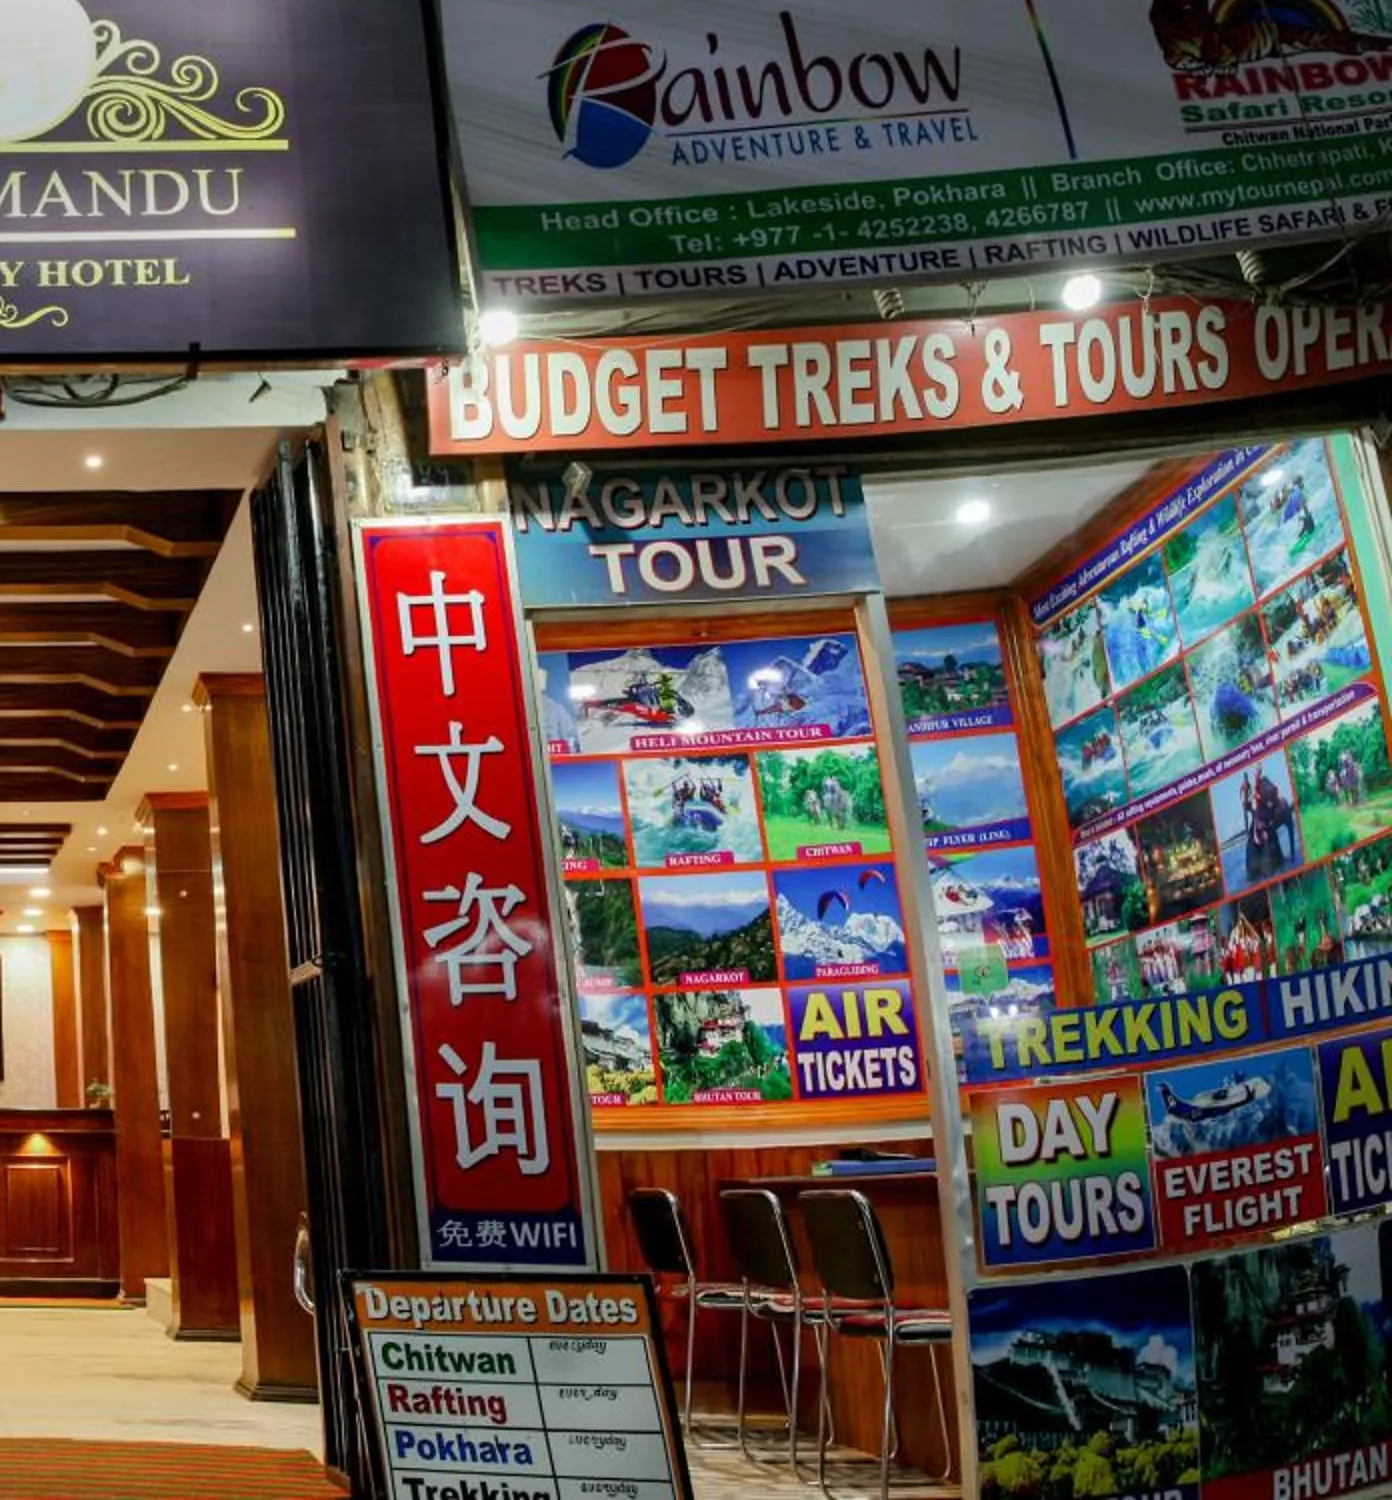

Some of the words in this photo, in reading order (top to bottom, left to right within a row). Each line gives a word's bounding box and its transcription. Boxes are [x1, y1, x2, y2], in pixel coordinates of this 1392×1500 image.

[535, 10, 961, 165] Rainbow
[1180, 98, 1289, 123] Safari
[1300, 91, 1392, 114] Reso
[671, 126, 841, 167] ADVENTURE
[853, 126, 872, 150] &
[882, 115, 978, 147] TRAVEL
[1222, 129, 1290, 146] Chitwan
[1293, 117, 1360, 141] National
[540, 206, 619, 233] Head
[629, 204, 719, 229] Office
[748, 191, 886, 219] Lakeside,
[893, 176, 1006, 207] Pokhara
[1052, 167, 1142, 192] Branch
[1156, 159, 1235, 182] Office:
[492, 273, 607, 298] TREKS
[634, 264, 747, 290] TOURS
[774, 248, 961, 283] ADVENTURE
[985, 234, 1108, 265] RAFTING
[1128, 219, 1250, 250] WILDLIFE
[1259, 206, 1346, 233] SAFARI
[1353, 202, 1370, 221] &
[669, 233, 723, 255] Tel:
[732, 226, 800, 249] +977
[857, 212, 977, 239] 4252238,
[985, 202, 1089, 229] 4266787
[37, 258, 191, 287] HOTEL
[446, 346, 727, 443] BUDGET
[747, 332, 961, 428] TREKS
[982, 327, 1022, 413] &
[1039, 304, 1229, 407] TOURS
[1254, 301, 1392, 381] OPER
[509, 466, 849, 534] NAGARKOT
[589, 534, 807, 594] TOUR
[681, 730, 773, 747] MOUNTAIN
[776, 727, 822, 740] TOUR
[396, 571, 549, 1175] 中文咨询
[669, 853, 721, 866] RAFTING
[685, 971, 745, 985] NAGARKOT
[799, 989, 909, 1041] AIR
[976, 990, 1248, 1069] TREKKING
[798, 1046, 916, 1093] TICKETS
[996, 1092, 1119, 1164] DAY
[1164, 1143, 1314, 1199] EVEREST
[986, 1171, 1146, 1247] TOURS
[1184, 1186, 1303, 1236] FLIGHT
[364, 1287, 538, 1329] Departure
[544, 1289, 638, 1324] Dates
[381, 1342, 516, 1375] Chitwan
[388, 1384, 508, 1424] Rafting
[395, 1430, 533, 1466] Pokhara
[1273, 1443, 1389, 1500] BHUTAN
